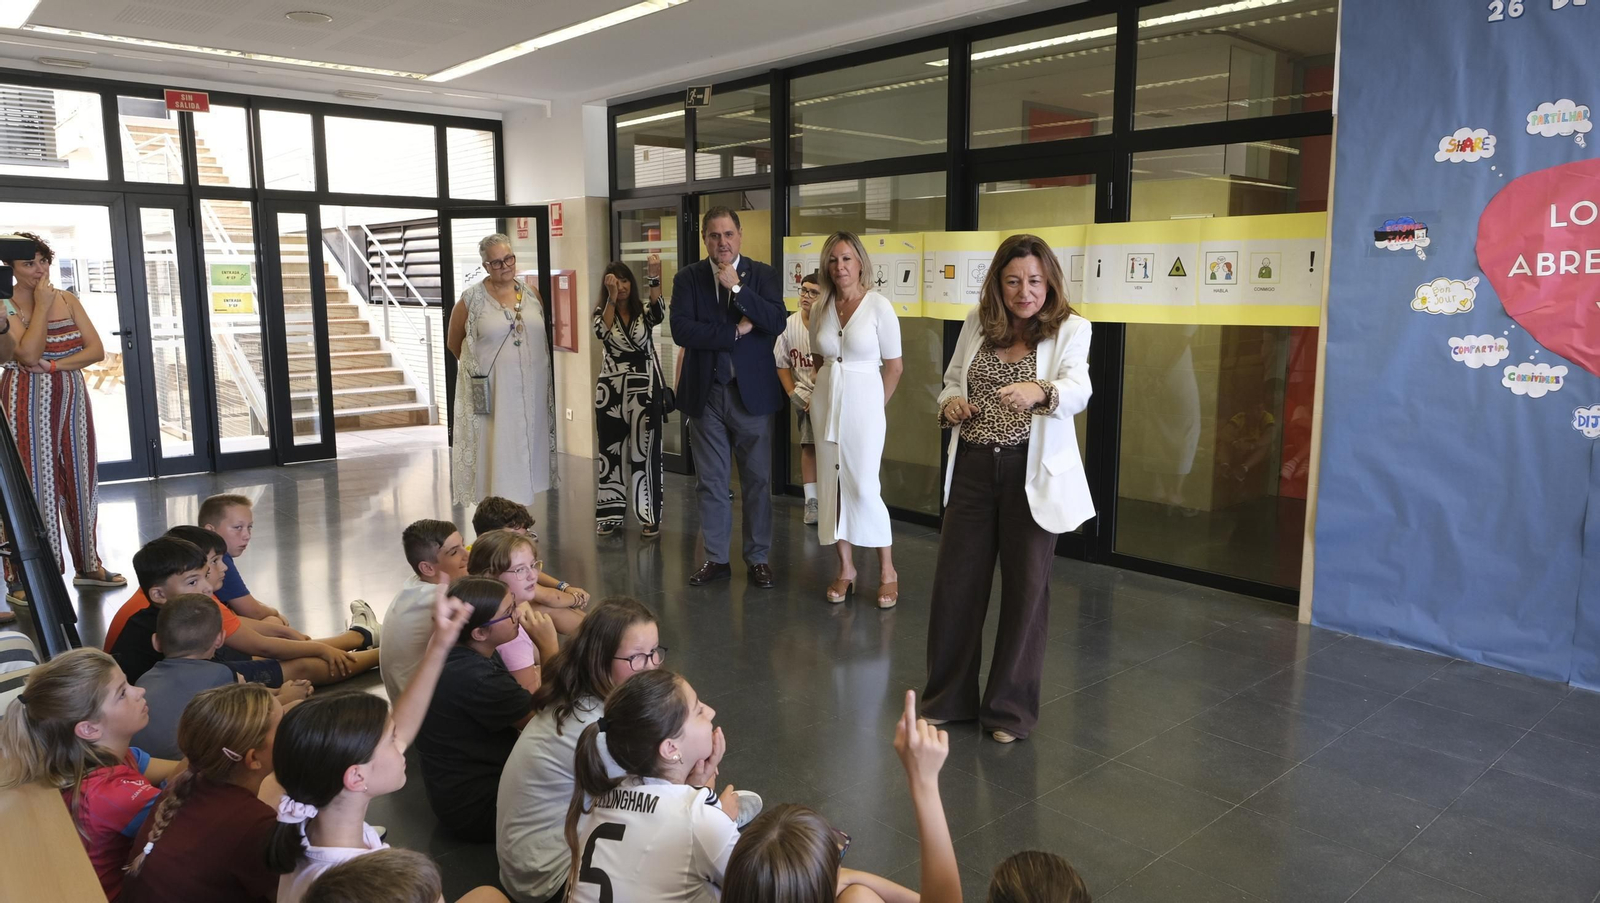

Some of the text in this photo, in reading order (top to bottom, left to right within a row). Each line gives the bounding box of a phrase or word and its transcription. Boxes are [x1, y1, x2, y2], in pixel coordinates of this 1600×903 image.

[1487, 0, 1524, 22] 26
[180, 93, 193, 102] SIN
[174, 101, 201, 110] SALIDA
[1445, 136, 1491, 152] SHARE
[1507, 249, 1600, 277] ABRE
[1432, 286, 1451, 294] Bon
[1434, 294, 1457, 305] jour
[578, 821, 627, 903] 5
